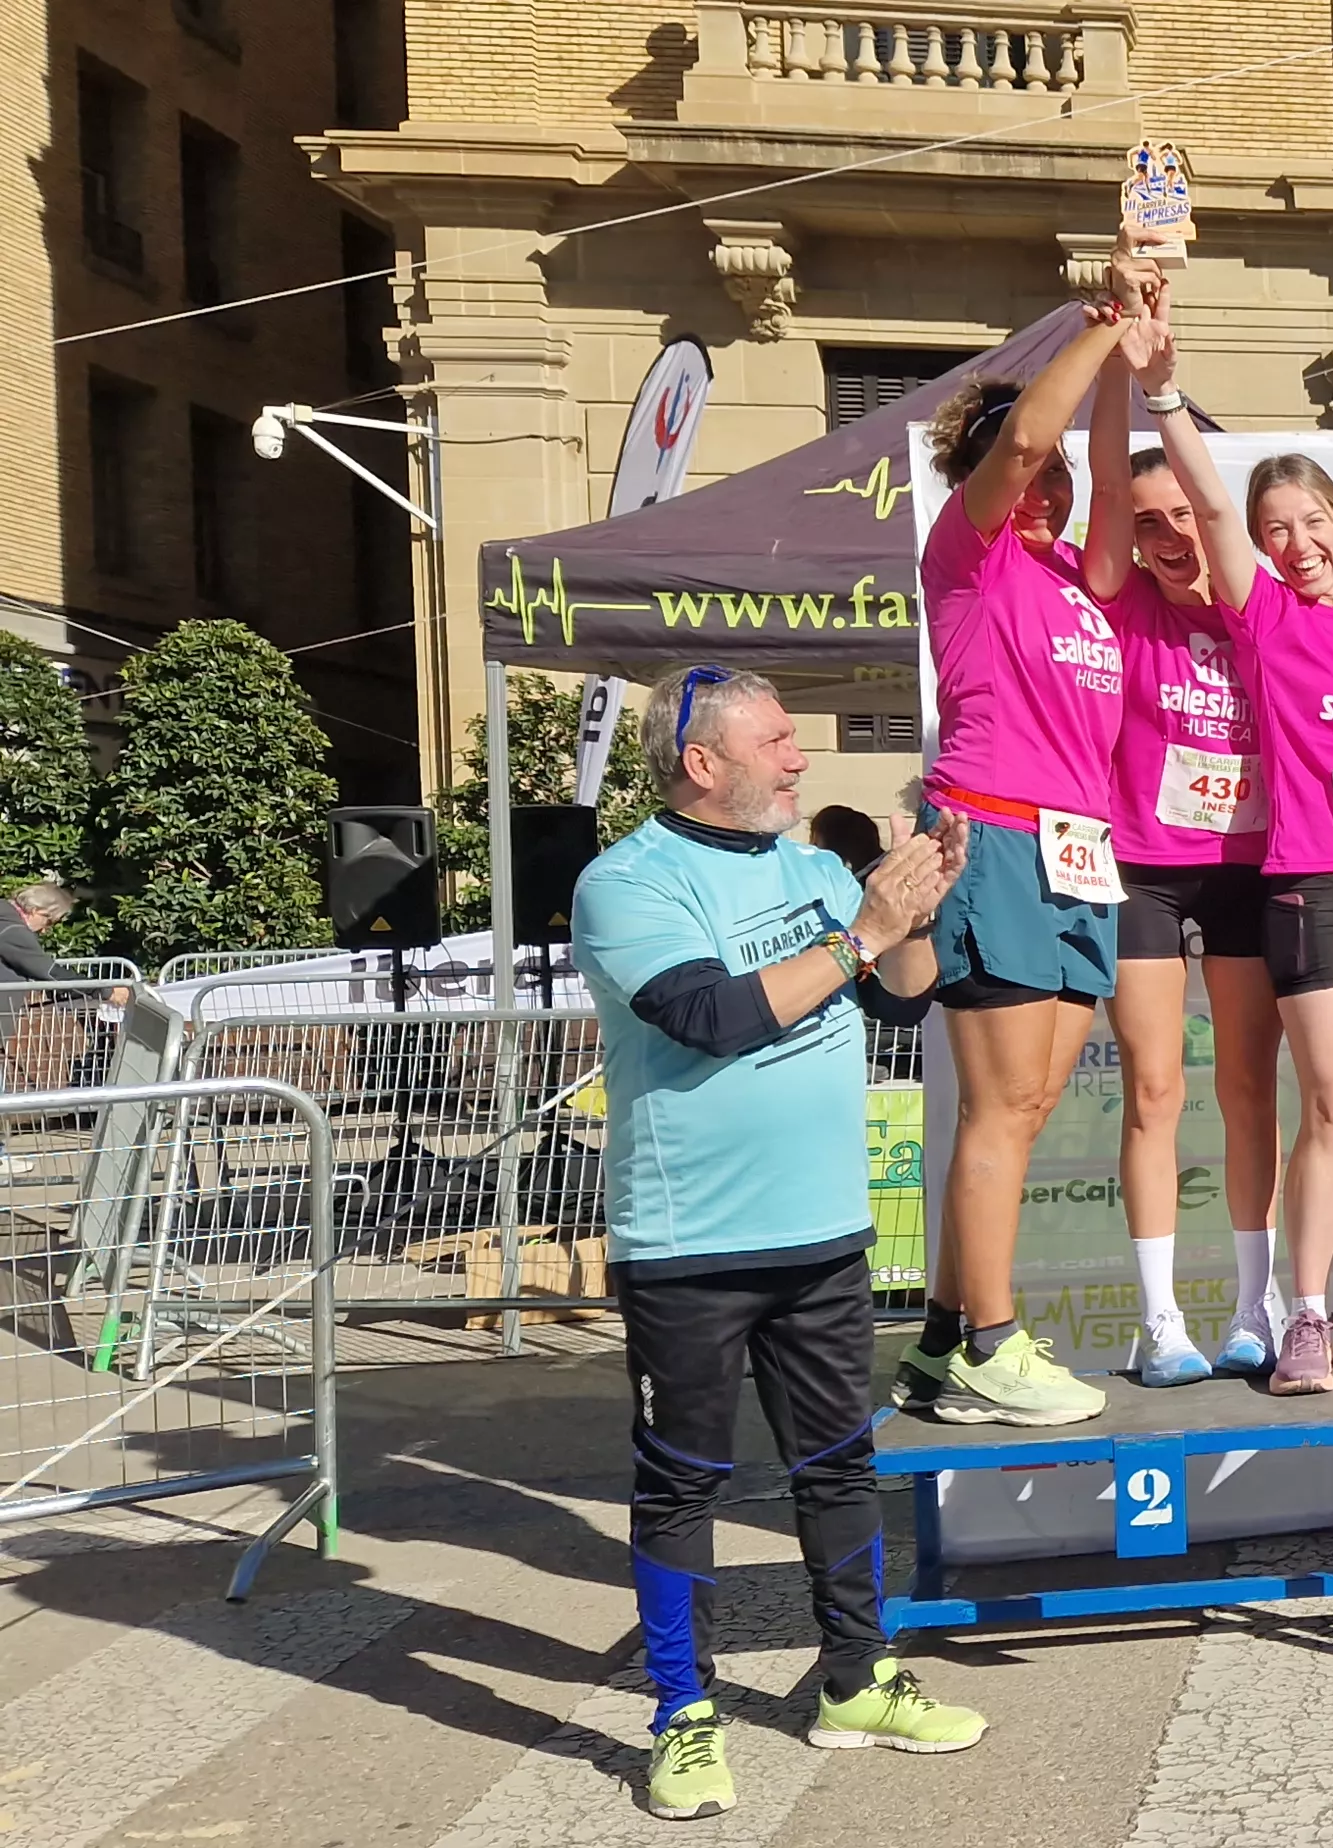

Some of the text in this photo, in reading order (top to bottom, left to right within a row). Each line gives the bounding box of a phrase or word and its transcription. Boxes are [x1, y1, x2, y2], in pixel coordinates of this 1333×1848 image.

[1137, 202, 1190, 223] EMPRESAS
[1180, 717, 1252, 742] HUESCA
[1188, 775, 1251, 801] 430
[1192, 811, 1214, 823] 8K
[1058, 843, 1096, 872] 431
[1074, 873, 1111, 888] ISABEL
[739, 943, 760, 967] III
[1128, 1468, 1173, 1527] 2
